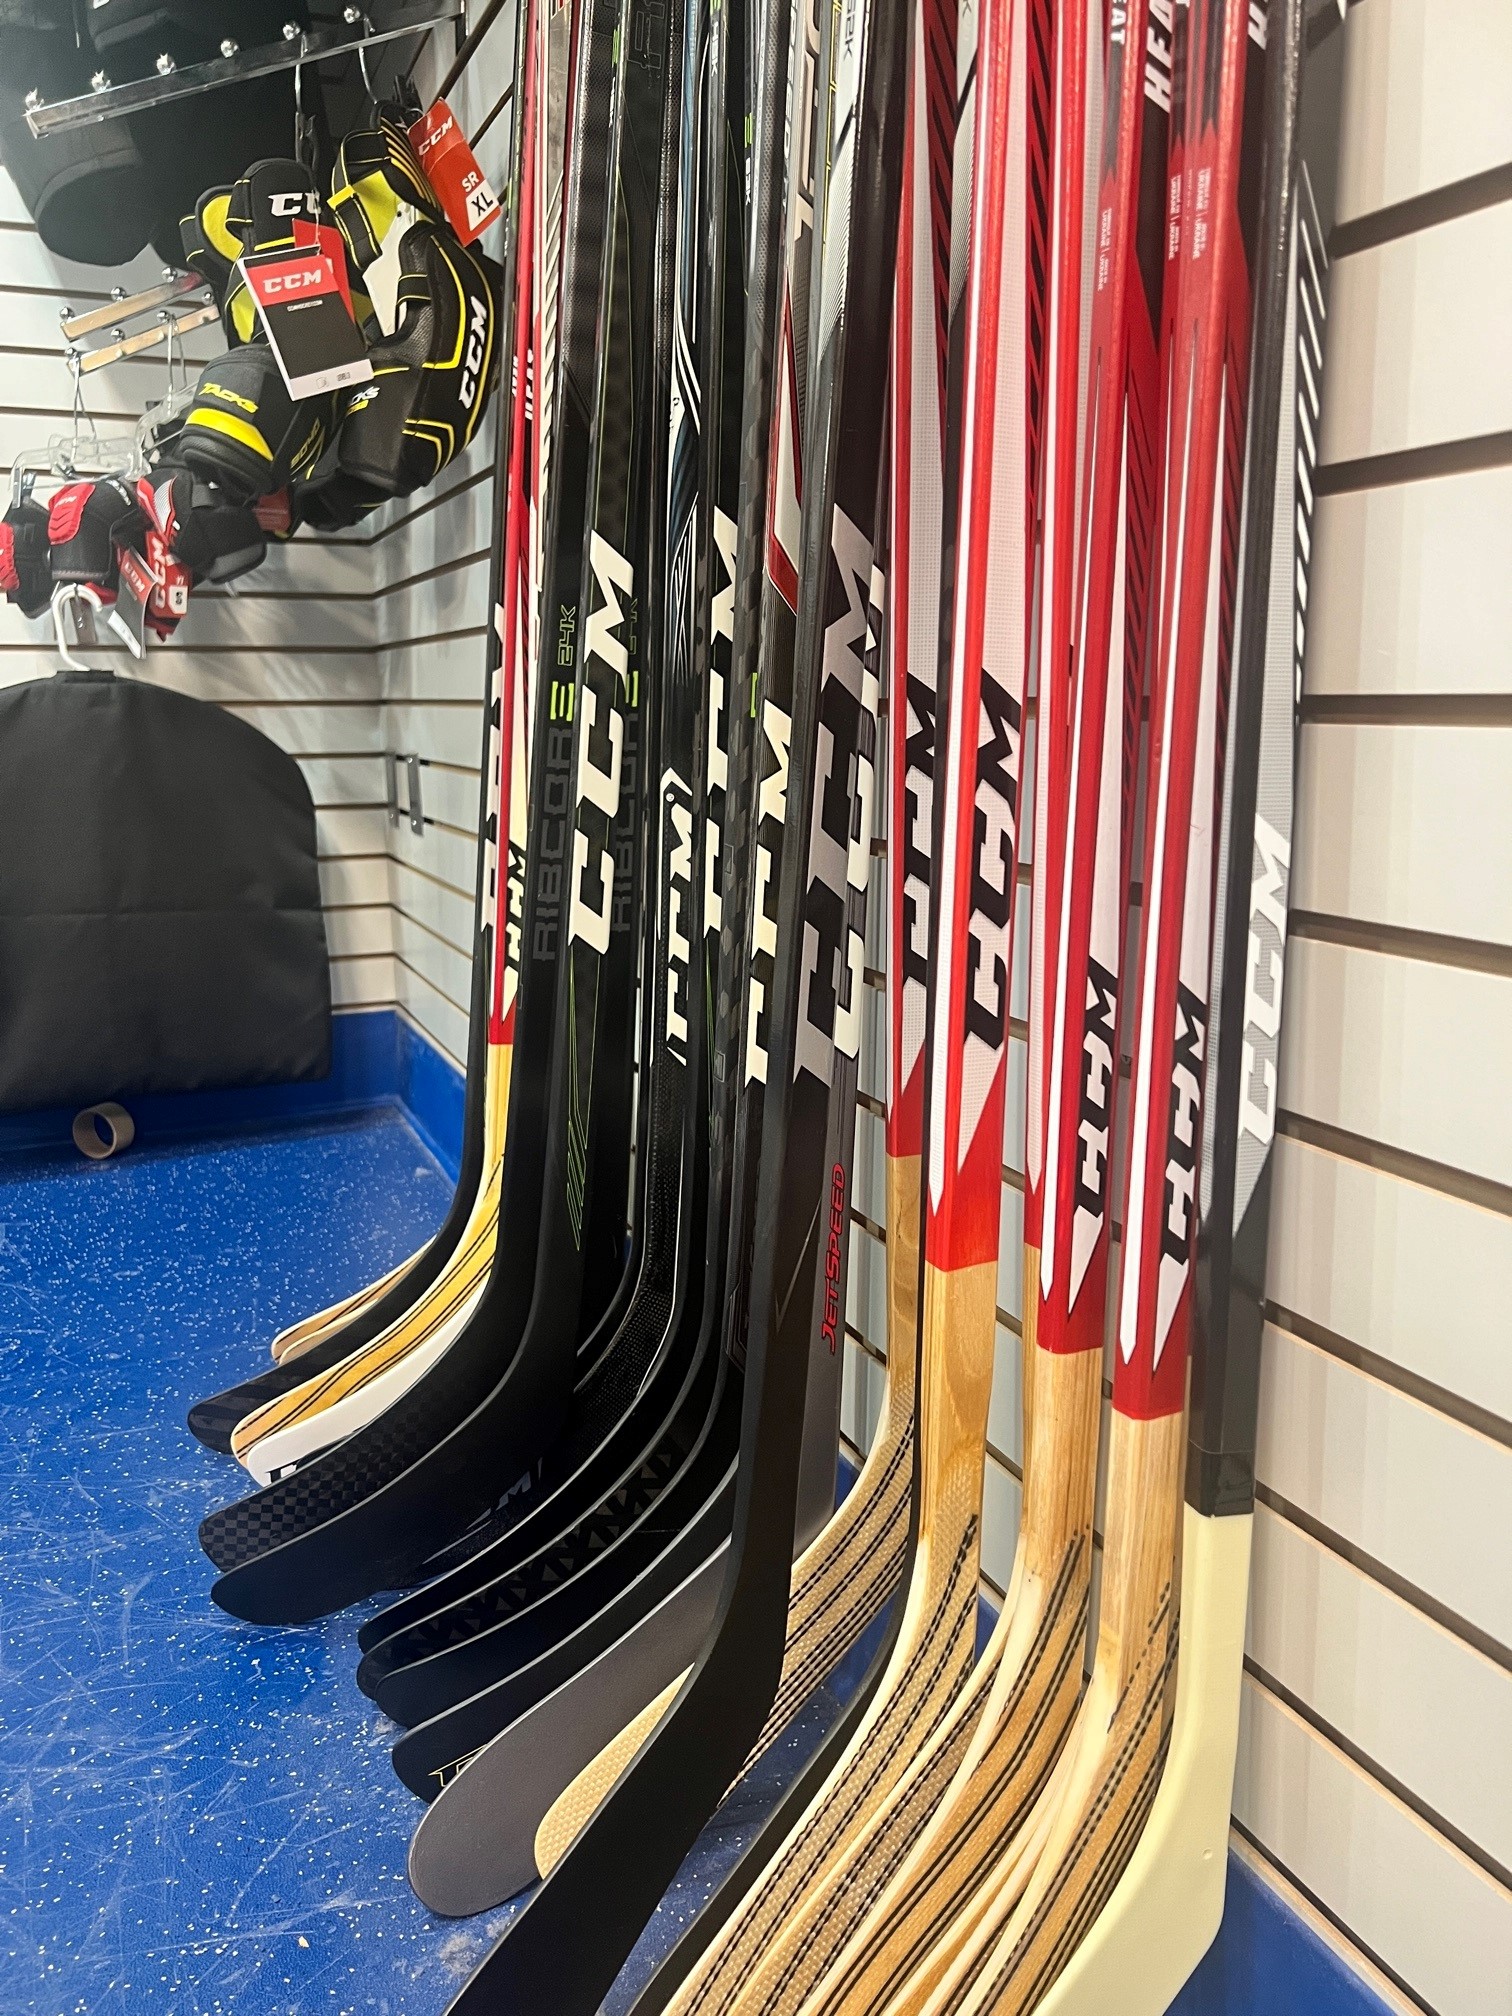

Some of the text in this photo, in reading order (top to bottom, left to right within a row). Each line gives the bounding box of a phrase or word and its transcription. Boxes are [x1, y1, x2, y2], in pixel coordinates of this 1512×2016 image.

[1111, 0, 1126, 45] AT
[1144, 0, 1173, 113] HEA
[418, 115, 453, 156] CCM
[461, 171, 480, 193] SR
[268, 191, 322, 217] CC
[471, 191, 493, 217] XL
[263, 268, 322, 293] CCM
[198, 382, 259, 414] TACKS
[458, 296, 488, 409] CCM
[152, 537, 168, 610] CCM
[557, 604, 576, 666] 24K
[567, 529, 634, 955] CCM
[793, 502, 873, 1088] CCM
[902, 667, 938, 993] CCM
[963, 666, 1021, 1051] CCM
[1238, 813, 1291, 1146] CCM
[1073, 954, 1118, 1216] CCM
[1159, 980, 1206, 1265] CCM
[821, 1162, 846, 1356] JETSPEED
